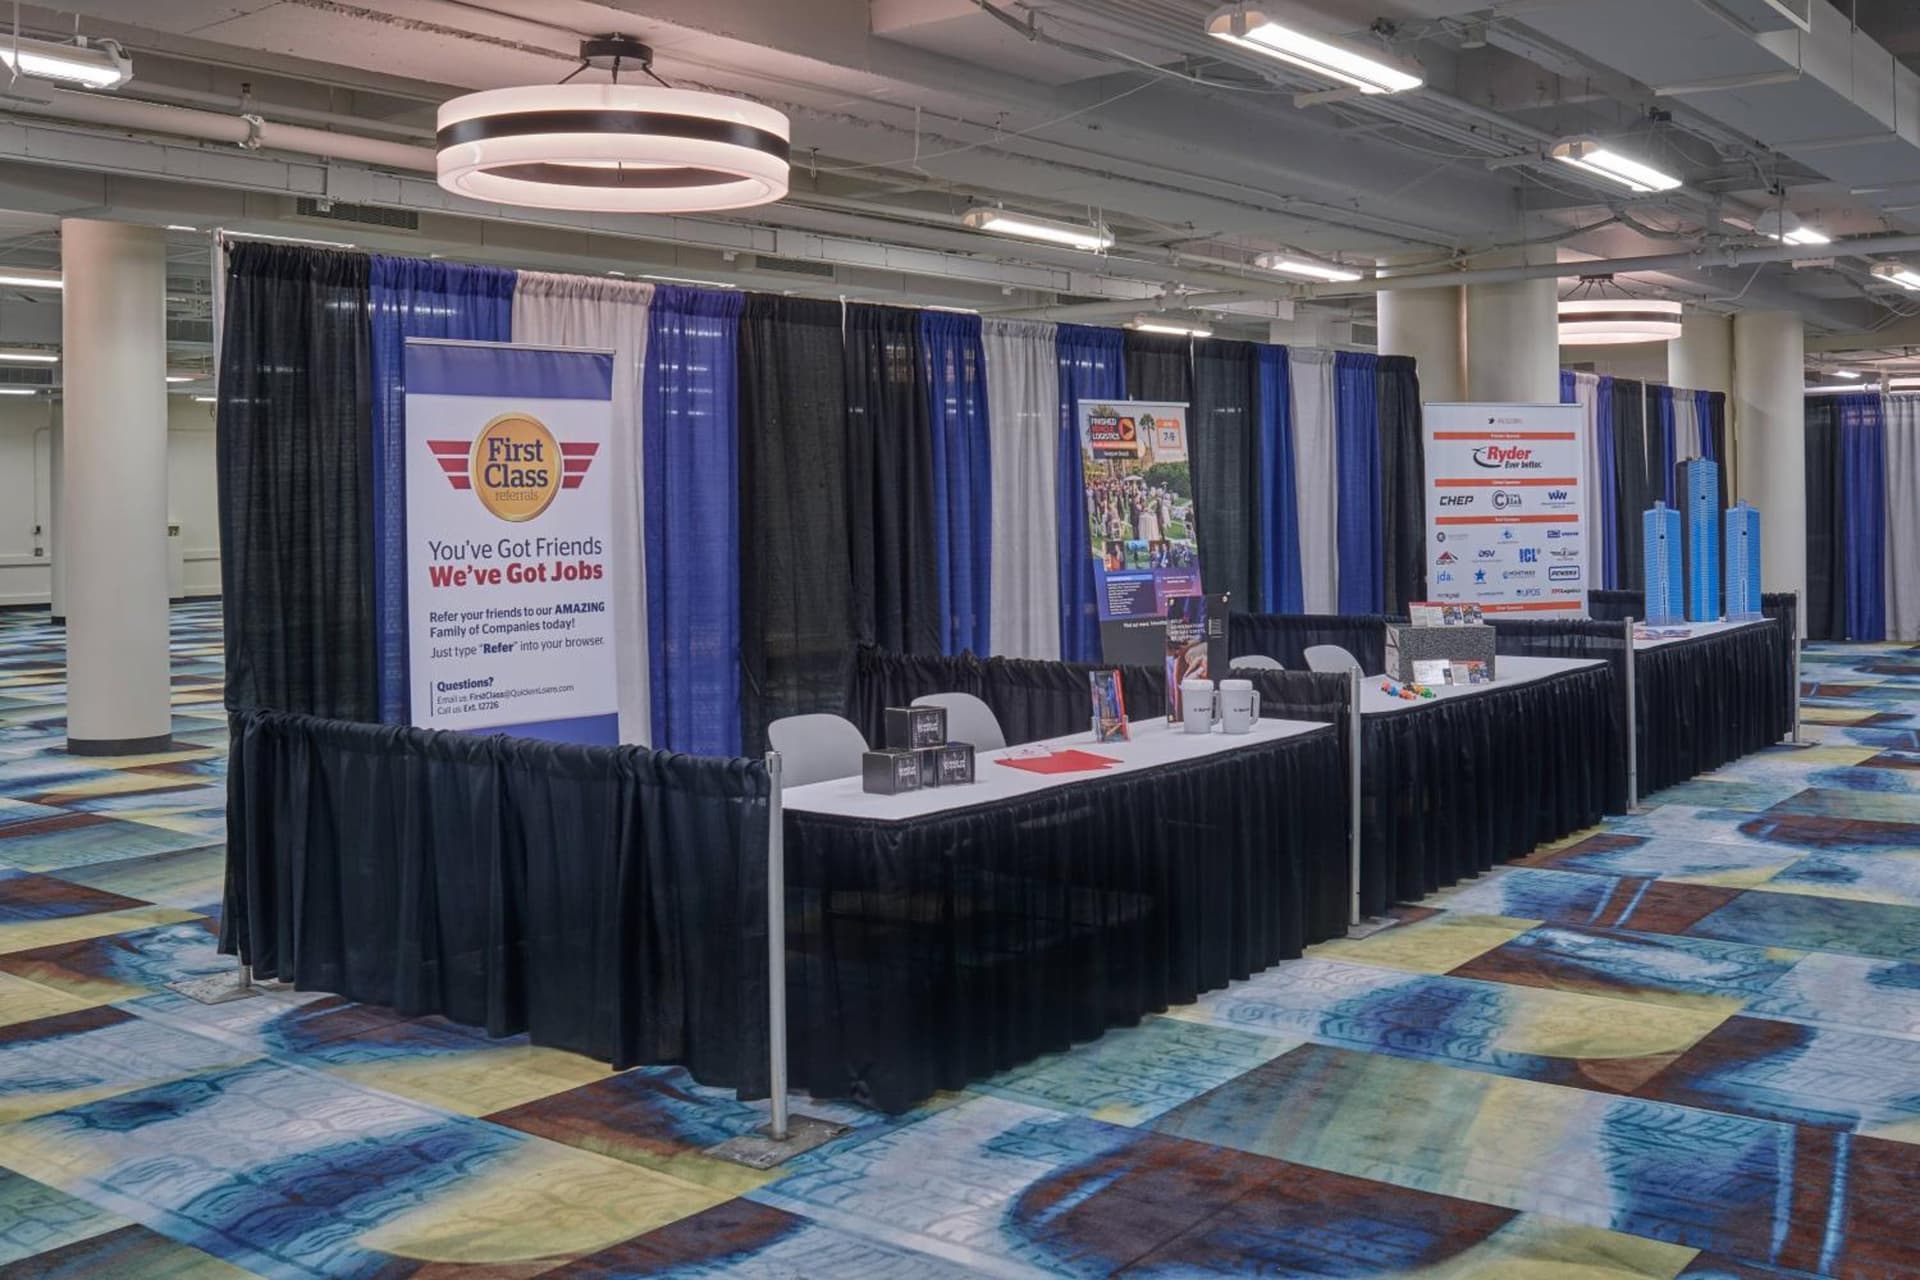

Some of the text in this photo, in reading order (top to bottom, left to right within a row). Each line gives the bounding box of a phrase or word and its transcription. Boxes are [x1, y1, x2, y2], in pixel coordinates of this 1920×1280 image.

[487, 437, 544, 462] First
[1487, 445, 1532, 463] Ryder
[1504, 460, 1520, 469] Ever
[484, 463, 548, 488] Class
[495, 489, 540, 501] referrals
[1439, 495, 1474, 506] CHEP
[429, 536, 603, 561] You've Got Friends
[1519, 548, 1537, 563] ICL
[429, 560, 604, 587] We've Got Jobs
[430, 601, 605, 625] Refer your friends to our AMAZING
[430, 618, 575, 639] Family of Companies today!
[431, 647, 452, 659] Just
[454, 645, 478, 660] type
[520, 640, 539, 652] into
[540, 639, 563, 652] your
[437, 676, 494, 692] Questions?
